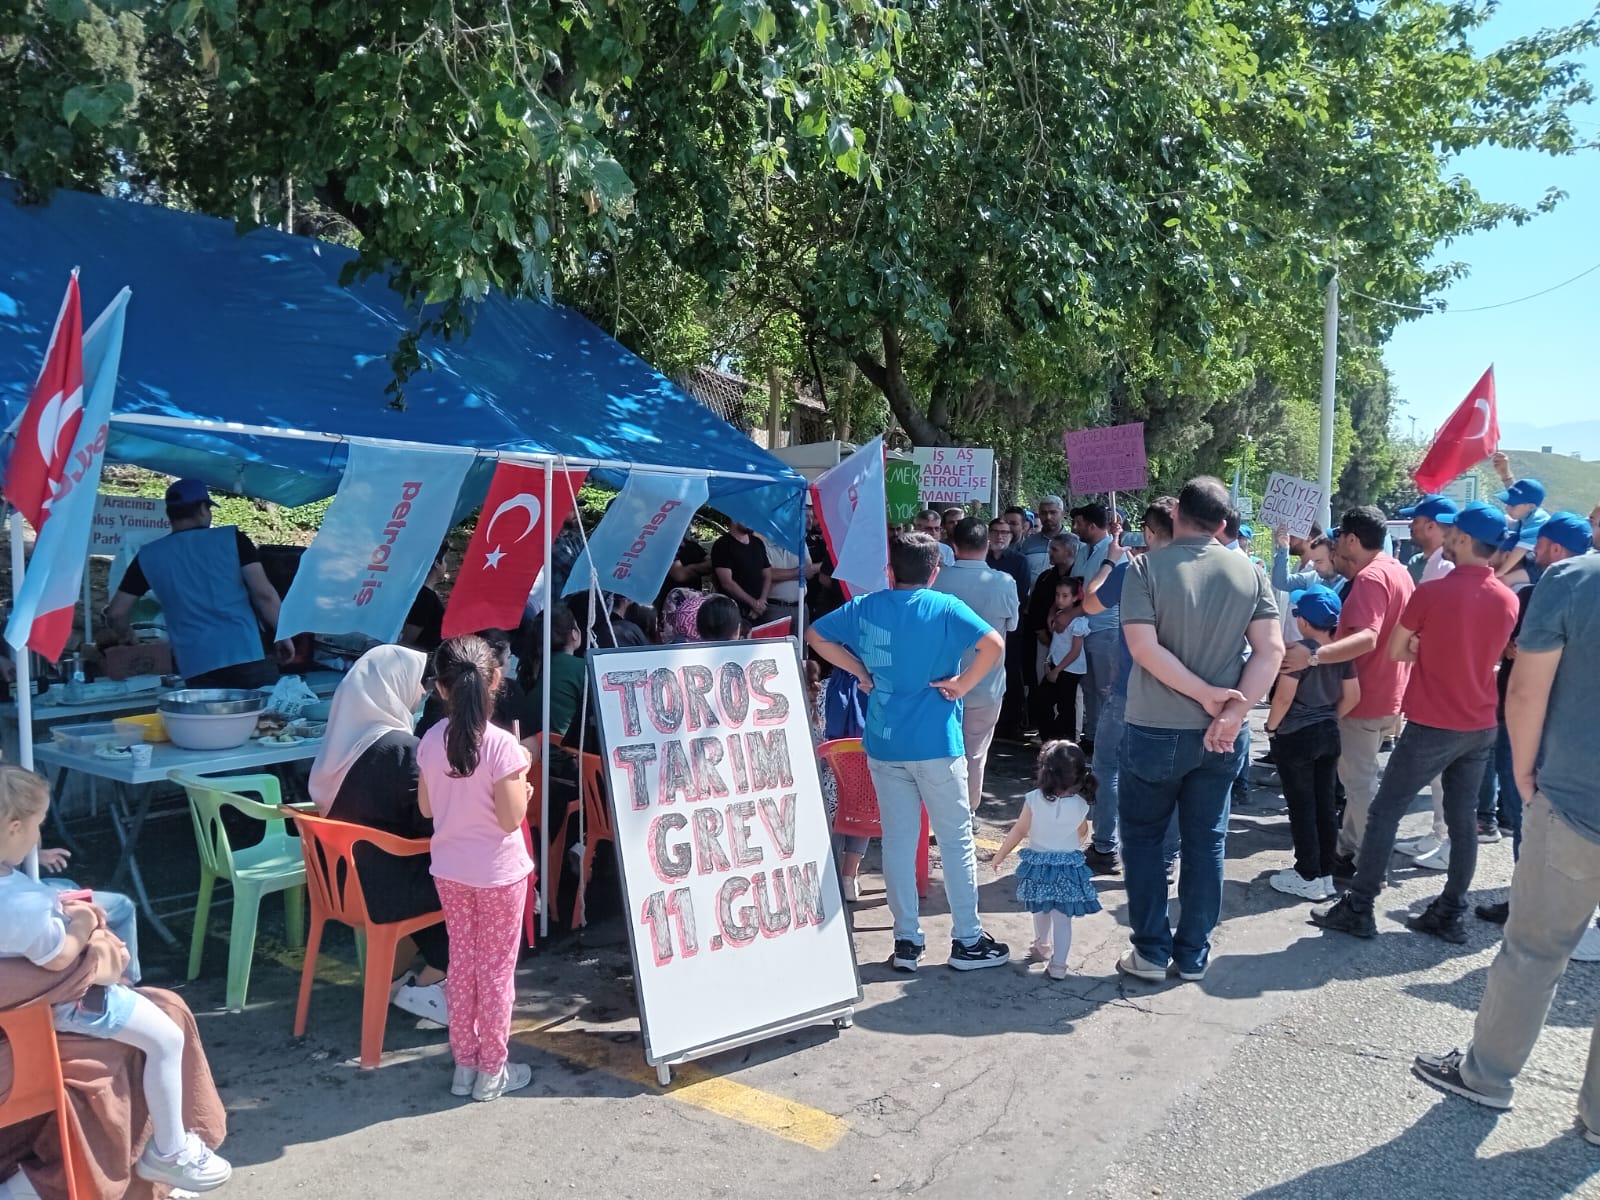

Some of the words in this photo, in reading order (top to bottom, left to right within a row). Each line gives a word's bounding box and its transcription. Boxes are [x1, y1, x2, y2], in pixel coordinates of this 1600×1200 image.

[923, 463, 975, 477] ADALET
[956, 448, 974, 463] AŞ
[93, 531, 122, 545] Park
[119, 514, 170, 529] Yönünde
[353, 481, 423, 607] petrol-iş
[602, 659, 789, 738] TOROS
[613, 729, 794, 811] TARIM
[648, 793, 798, 884] GREV
